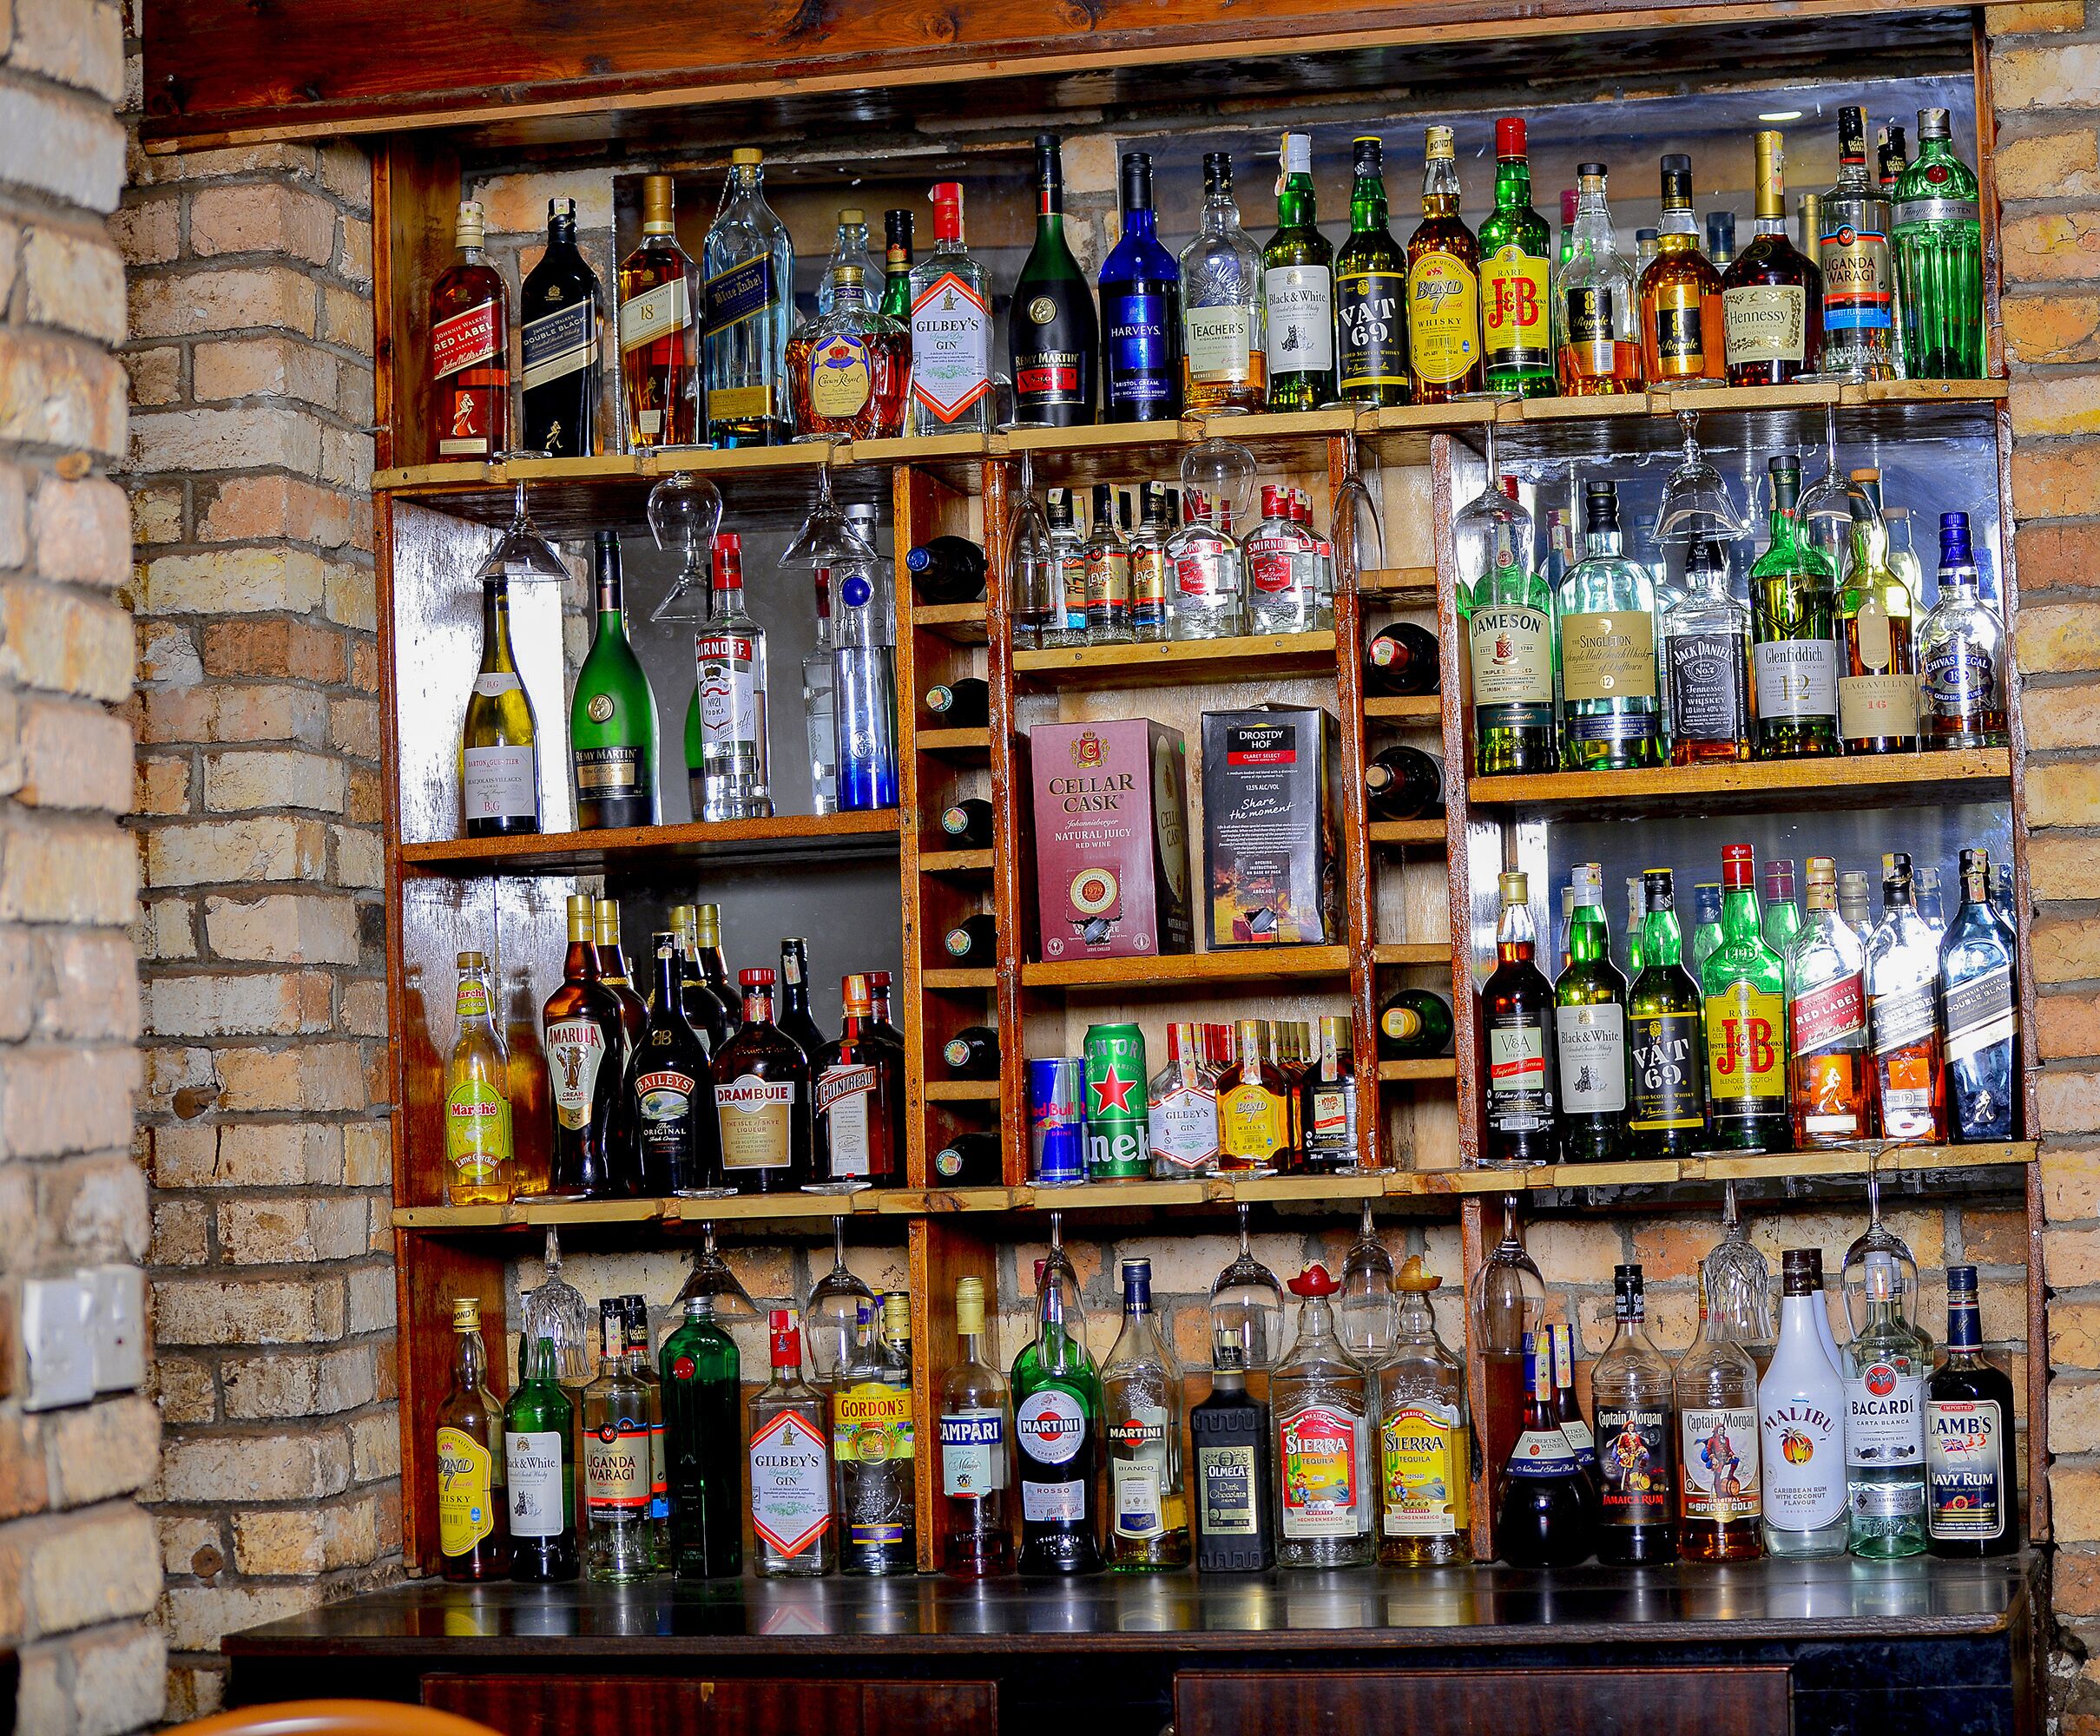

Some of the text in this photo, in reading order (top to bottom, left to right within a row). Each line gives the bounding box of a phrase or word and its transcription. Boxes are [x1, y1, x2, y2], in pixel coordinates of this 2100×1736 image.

[1825, 258, 1875, 272] UGANDA
[1497, 268, 1524, 277] RARE
[1826, 270, 1875, 284] WARAGI
[1415, 279, 1464, 300] BOND
[1268, 293, 1289, 306] Black
[1291, 293, 1299, 303] &
[1429, 293, 1445, 314] 7
[1488, 277, 1538, 329] J&B
[1583, 292, 1595, 310] 8
[640, 305, 654, 320] 18
[1340, 298, 1396, 327] VAT
[1729, 309, 1788, 326] Hennessy
[916, 317, 979, 332] GILBEY'S
[1418, 318, 1462, 328] WHISKY
[434, 322, 493, 352] RED LABEL
[523, 317, 588, 346] DOUBLE BLACK
[1191, 322, 1245, 340] TEACHER'S
[936, 341, 958, 350] GIN
[1038, 352, 1077, 365] MARTIN
[1473, 614, 1542, 638] JAMESON
[1673, 645, 1698, 666] JACK
[1766, 645, 1824, 665] Glenfiddich
[1695, 666, 1715, 675] No.7
[1926, 656, 1954, 674] CHIVAS
[1603, 676, 1612, 687] 12
[1781, 674, 1811, 701] 12
[1845, 680, 1909, 691] LAGAVULIN
[1686, 684, 1727, 694] Tennessee
[1688, 697, 1726, 707] WHISKEY
[1867, 700, 1888, 710] 16
[1240, 730, 1284, 740] DROSTDY
[1252, 740, 1272, 749] HOF
[597, 749, 635, 760] MARTIN
[1049, 773, 1136, 796] CELLAR
[1063, 795, 1119, 813] CASK
[1228, 801, 1296, 820] the moment
[1241, 798, 1276, 810] Share
[1065, 819, 1119, 831] Johannisberger
[1055, 828, 1132, 841] NATURAL JUICY
[1084, 887, 1103, 896] 1979
[1946, 981, 2013, 1014] DOUBLE BLACK
[1728, 1009, 1759, 1017] RARE
[1795, 993, 1860, 1026] RED LABEL
[548, 1025, 602, 1051] AMARULA
[1500, 1034, 1531, 1053] V&A
[1561, 1030, 1582, 1044] Black
[1583, 1032, 1591, 1043] &
[1716, 1017, 1775, 1075] J&B
[1633, 1038, 1689, 1069] VAT
[1493, 1060, 1542, 1078] Imperial Cream
[637, 1074, 690, 1091] BAILEYS
[820, 1071, 873, 1100] COINTREAU
[718, 1087, 788, 1101] DRAMBUIE
[1234, 1101, 1267, 1114] BOND
[1247, 1112, 1255, 1123] 7
[456, 1154, 472, 1168] Lime
[841, 1397, 904, 1417] GORDON'S
[1852, 1394, 1914, 1416] BACARDÍ
[1598, 1410, 1663, 1426] Captain Morgan
[1687, 1413, 1754, 1430] Captain Morgan
[1763, 1406, 1835, 1435] MALIBU
[1022, 1420, 1081, 1433] MARTINI
[1931, 1416, 1992, 1435] LAMB'S
[1109, 1427, 1162, 1439] MARTINI
[1285, 1432, 1348, 1456] SIERRA
[1385, 1431, 1445, 1453] SIERRA
[520, 1458, 527, 1469] &
[587, 1455, 635, 1468] UGANDA
[755, 1453, 820, 1467] GILBEY'S
[588, 1468, 635, 1480] WARAGI
[1208, 1465, 1247, 1477] OLMECA
[1517, 1464, 1544, 1476] Natural
[1544, 1464, 1562, 1475] Sweet
[444, 1471, 454, 1491] 7
[776, 1476, 797, 1485] GIN
[1963, 1472, 1993, 1484] RUM
[1219, 1482, 1240, 1491] Dark
[1208, 1489, 1247, 1500] Chocolate
[1603, 1495, 1664, 1505] JAMAICA RUM
[1695, 1501, 1754, 1512] SPICED GOLD
